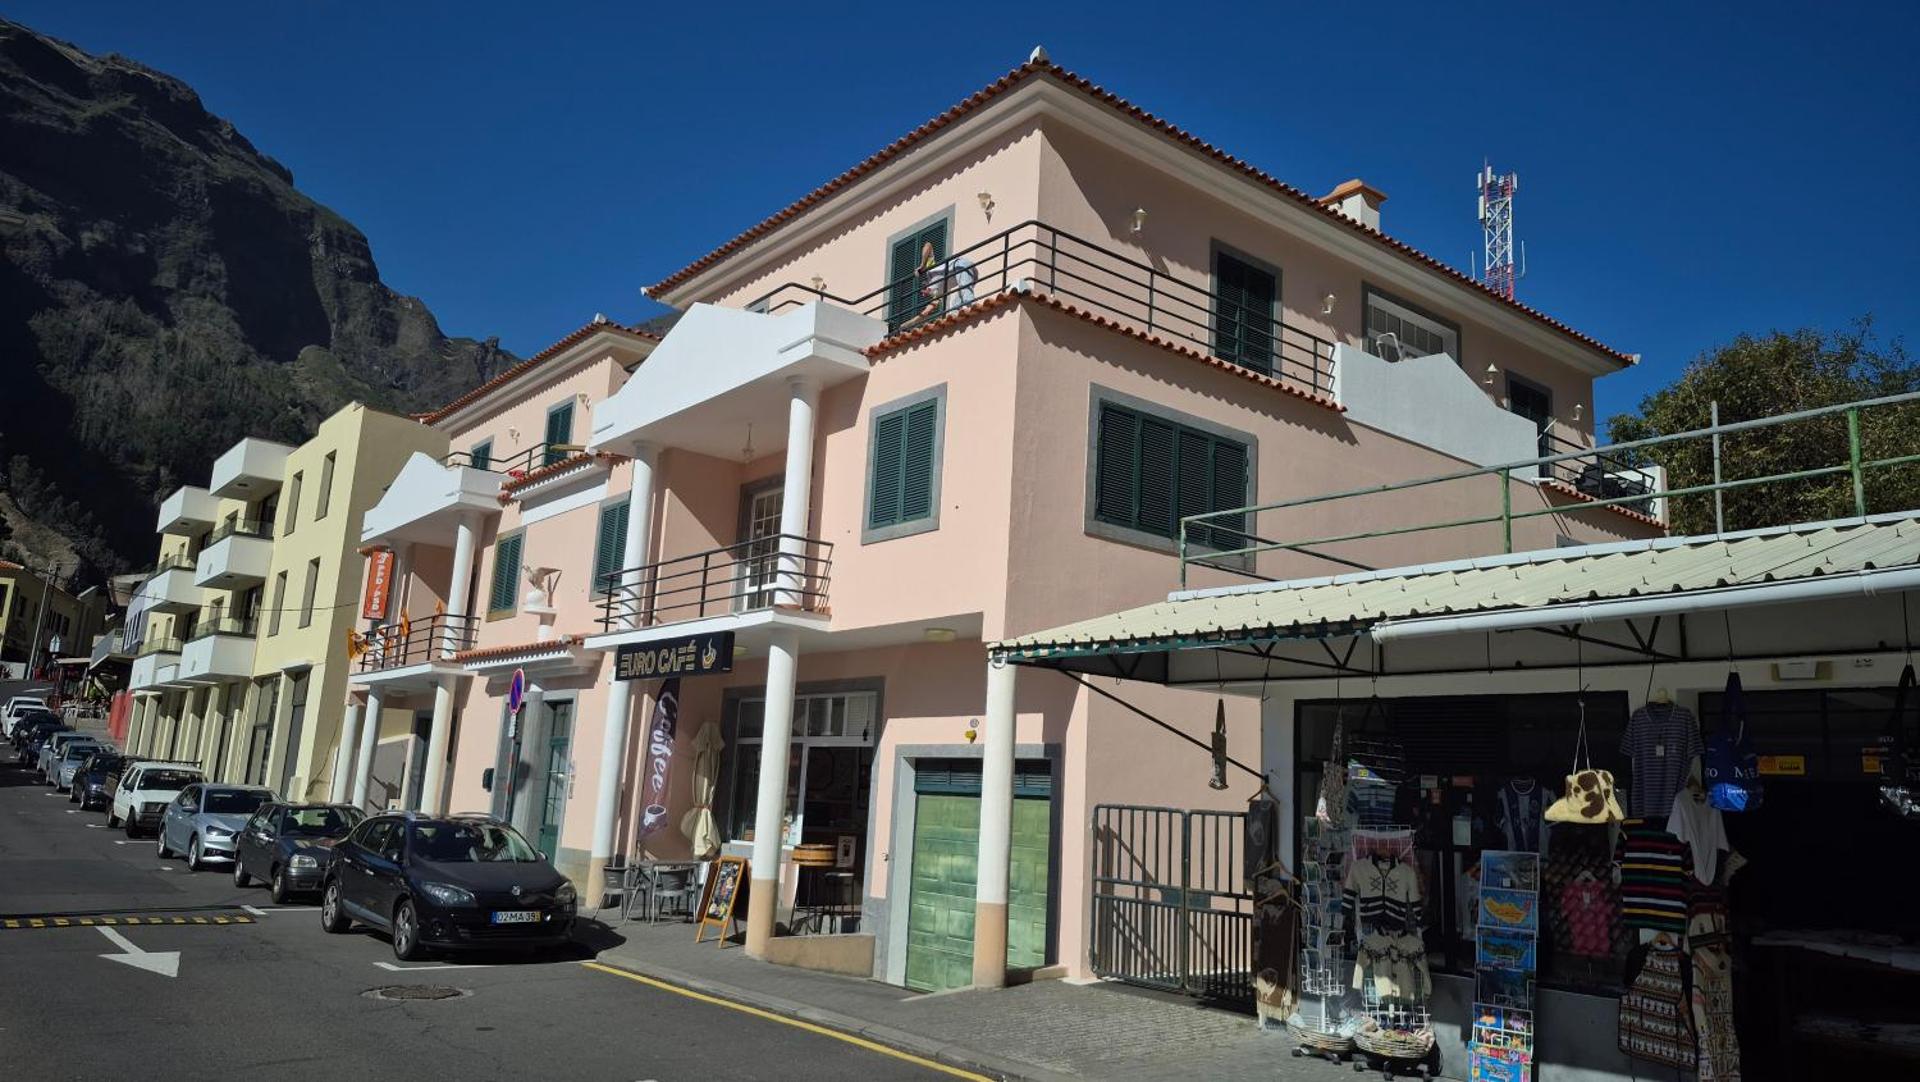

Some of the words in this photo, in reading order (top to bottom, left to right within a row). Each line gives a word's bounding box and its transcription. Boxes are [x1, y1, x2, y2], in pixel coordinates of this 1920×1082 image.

[619, 650, 656, 677] EURO
[658, 639, 697, 673] CAFÉ
[651, 692, 678, 793] Coffee
